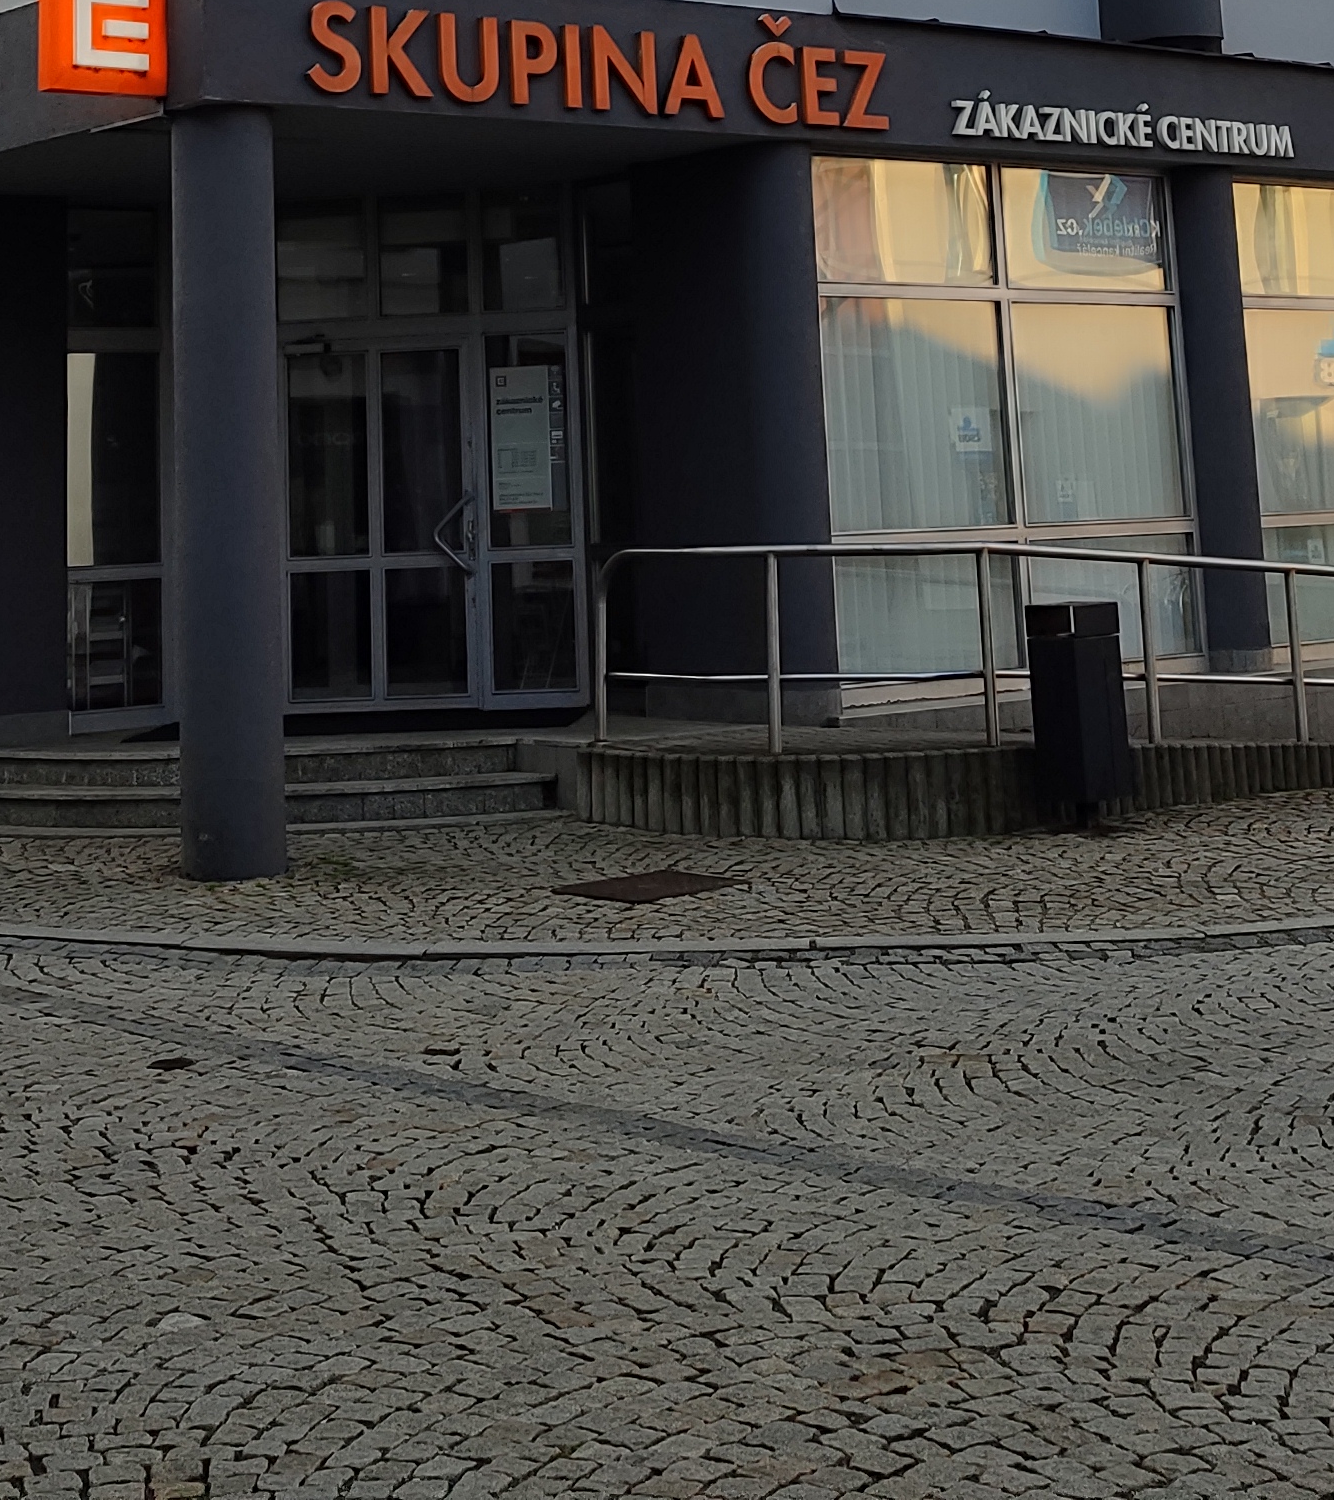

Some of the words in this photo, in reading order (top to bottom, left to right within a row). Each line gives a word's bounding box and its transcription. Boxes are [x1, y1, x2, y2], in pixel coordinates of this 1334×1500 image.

[306, 0, 726, 119] SKUPINA
[747, 13, 891, 130] ČEZ
[951, 89, 1154, 148] ZÁKAZNICKÉ
[1156, 115, 1296, 158] CENTRUM
